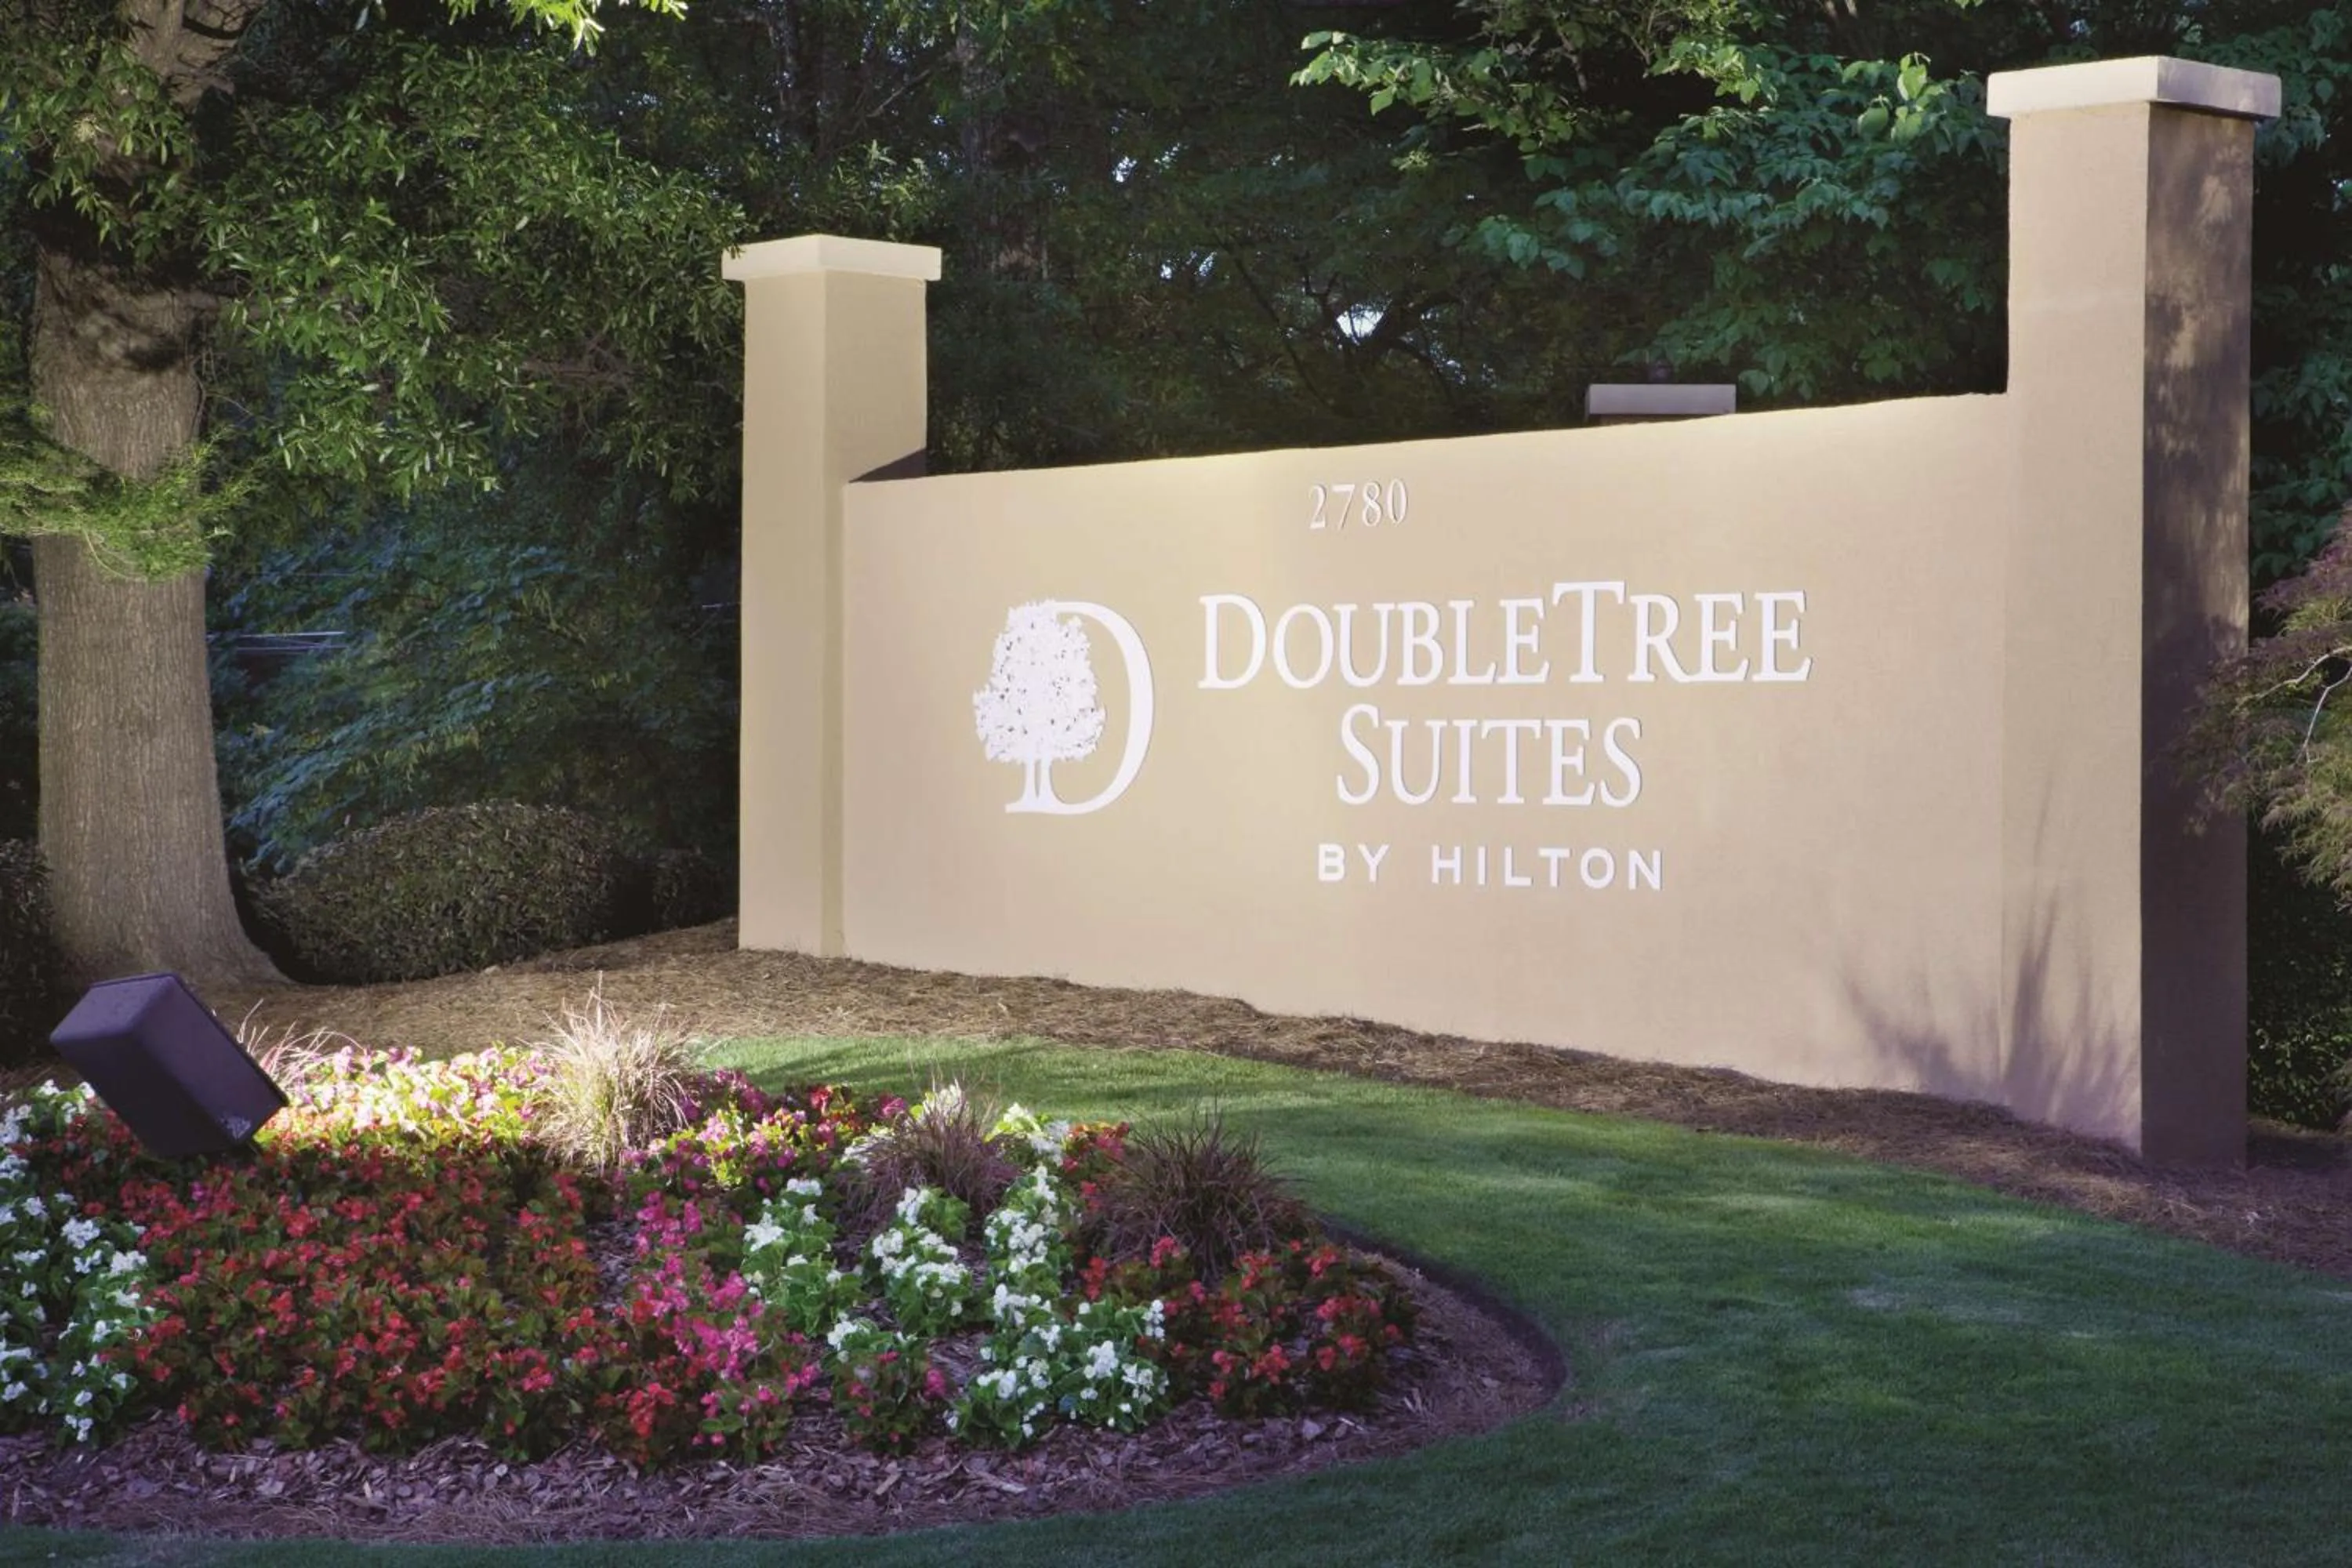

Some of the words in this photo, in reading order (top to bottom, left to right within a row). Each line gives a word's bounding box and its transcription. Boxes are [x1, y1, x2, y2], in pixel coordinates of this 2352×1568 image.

[1308, 479, 1408, 530] 2780
[1336, 703, 1642, 808] SUITES
[1318, 844, 1390, 882] BY
[1432, 845, 1663, 891] HILTON
